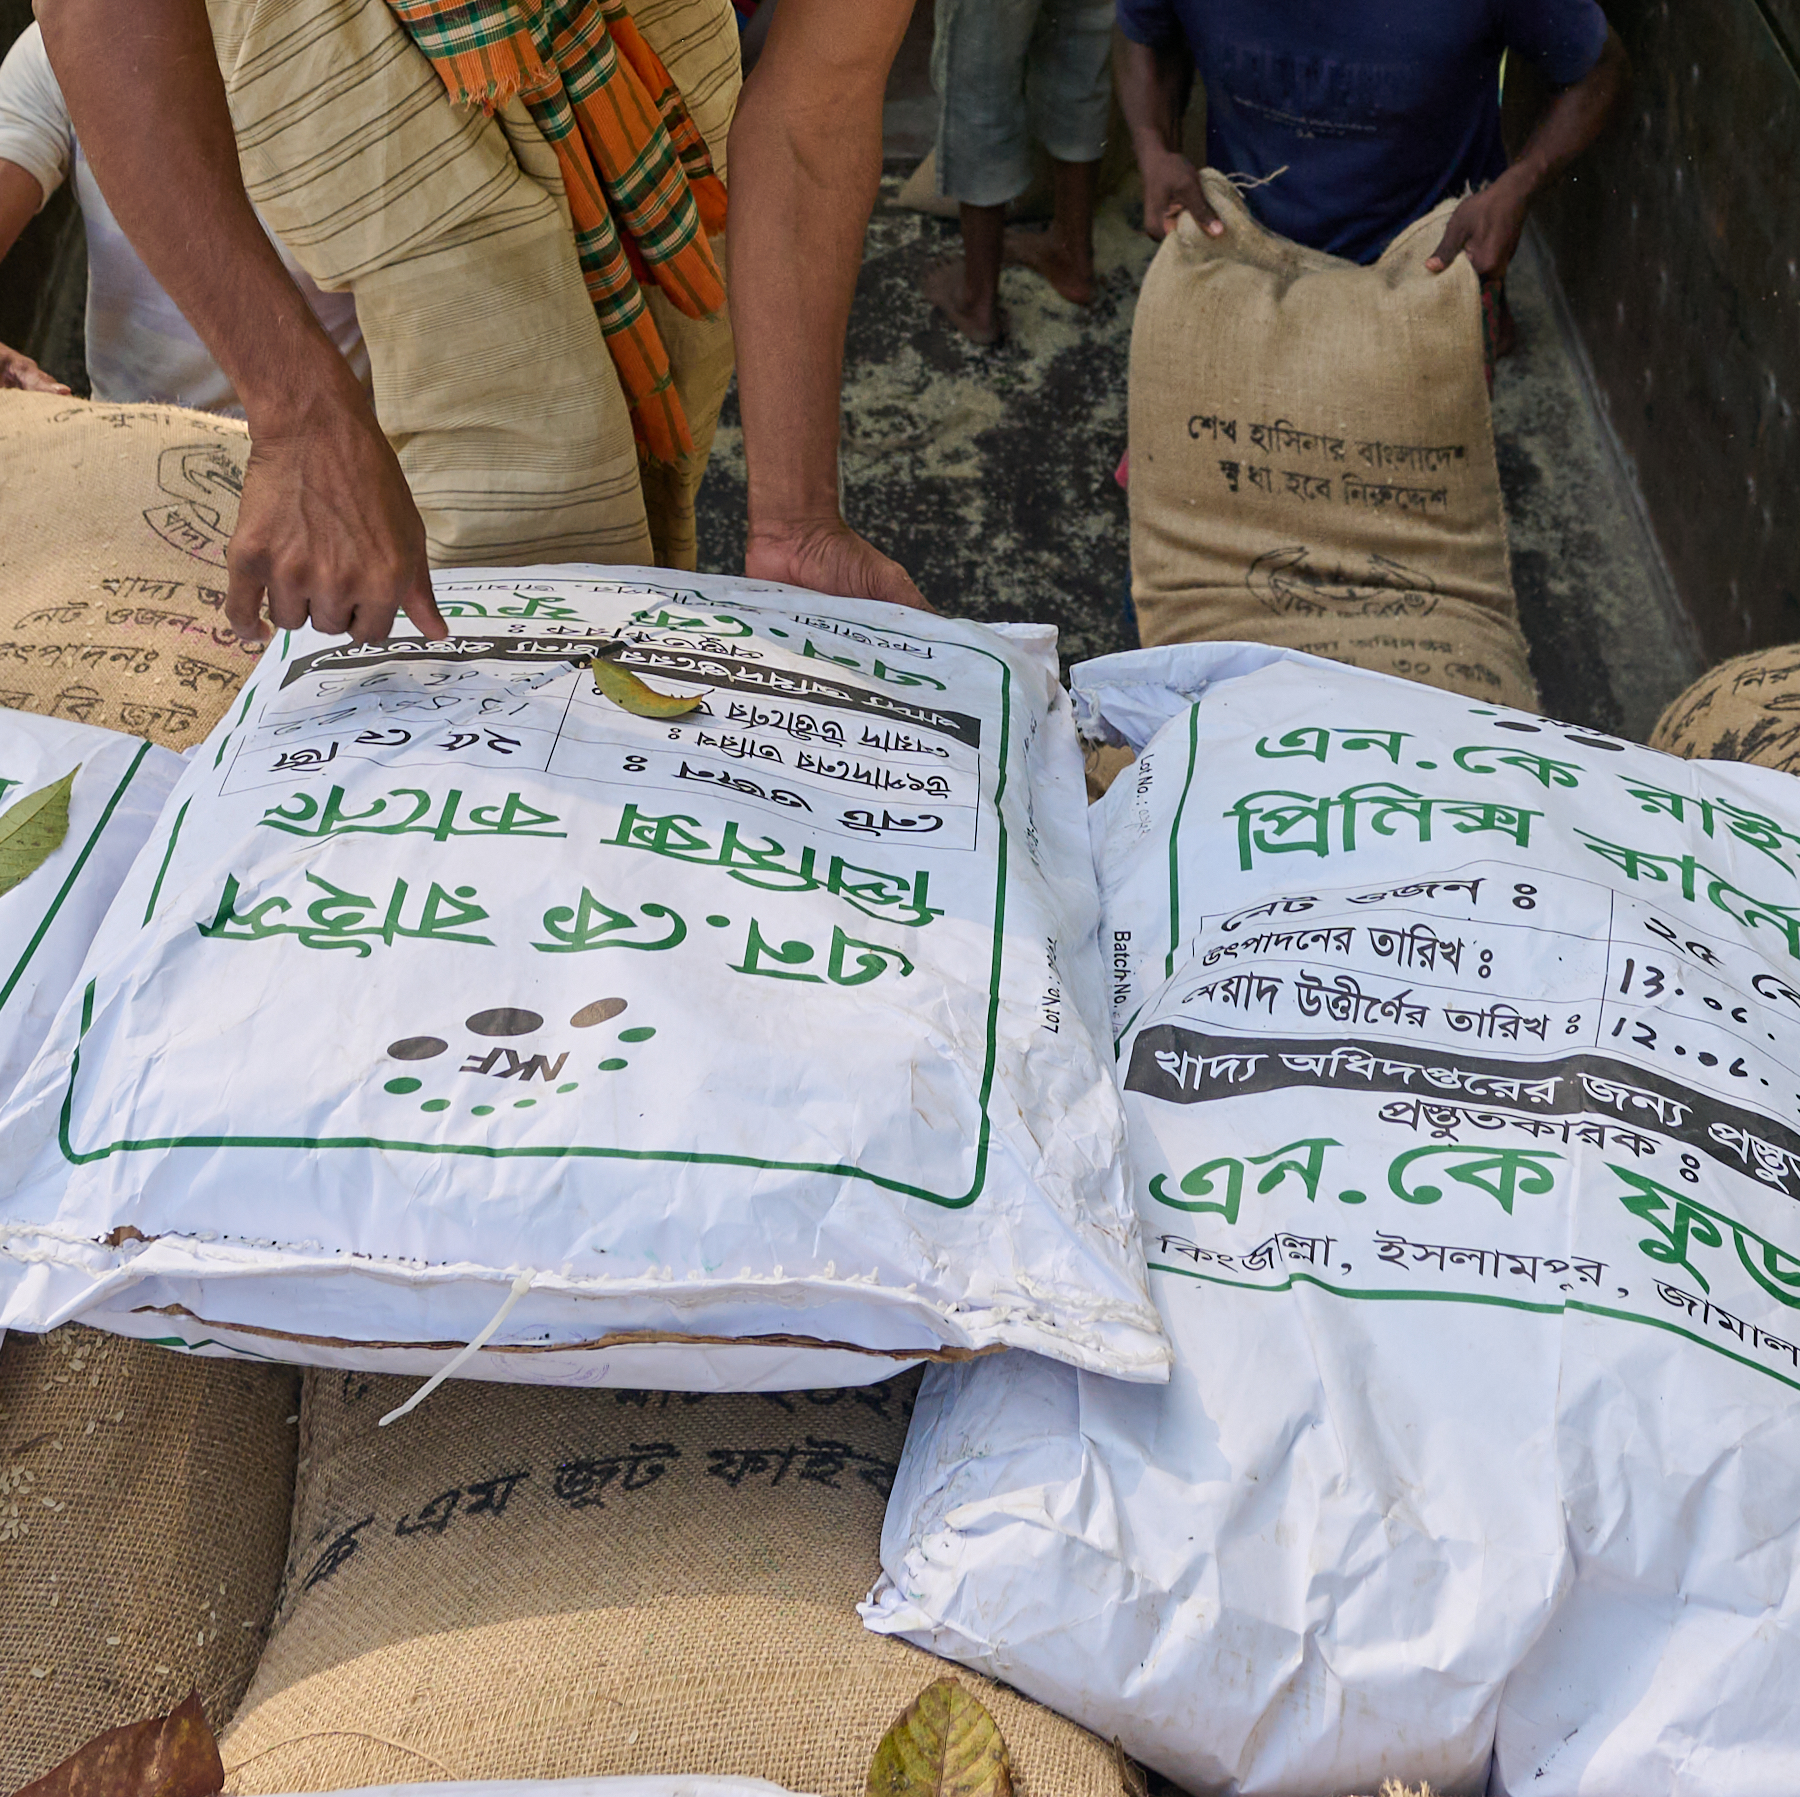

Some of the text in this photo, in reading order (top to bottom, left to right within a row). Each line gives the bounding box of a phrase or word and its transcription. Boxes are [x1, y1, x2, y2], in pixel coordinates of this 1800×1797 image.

[195, 868, 497, 959] রাইস
[1112, 930, 1132, 982] Batch
[1367, 923, 1467, 975] তারিখ
[1442, 1003, 1552, 1043] তারিখ
[459, 1045, 571, 1082] NKF
[1153, 1047, 1267, 1093] খাদ্য
[1576, 1072, 1695, 1129] জন্য
